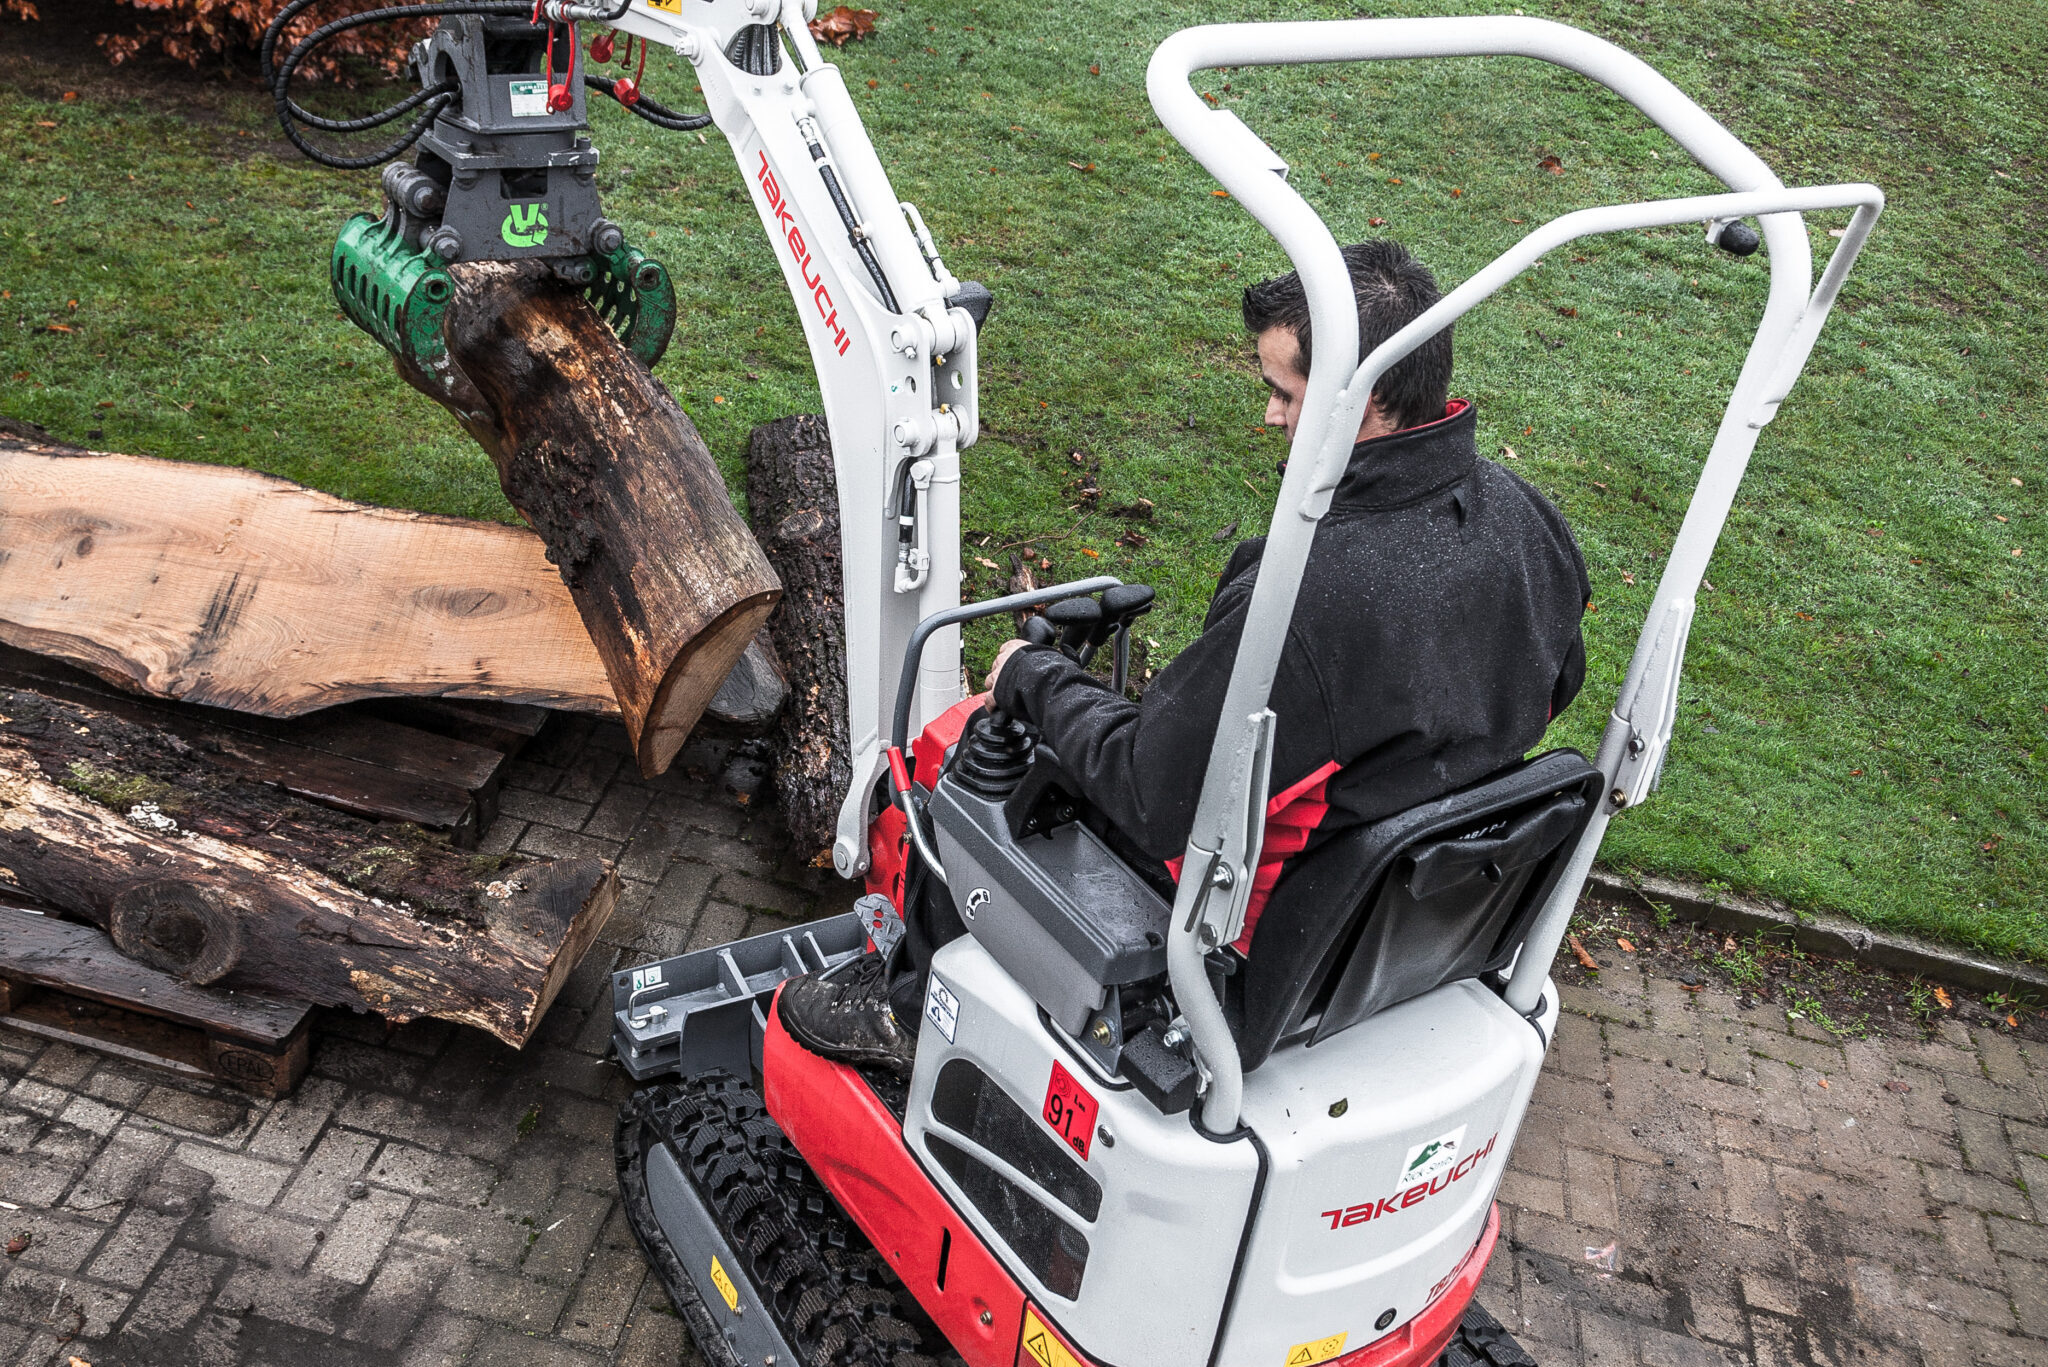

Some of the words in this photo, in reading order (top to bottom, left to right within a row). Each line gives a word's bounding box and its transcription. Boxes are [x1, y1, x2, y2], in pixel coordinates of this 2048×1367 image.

[758, 150, 850, 357] TAKEUCHI
[1048, 1094, 1074, 1138] 91
[1072, 1136, 1085, 1153] dB
[1321, 1132, 1498, 1230] TAKEUCHI
